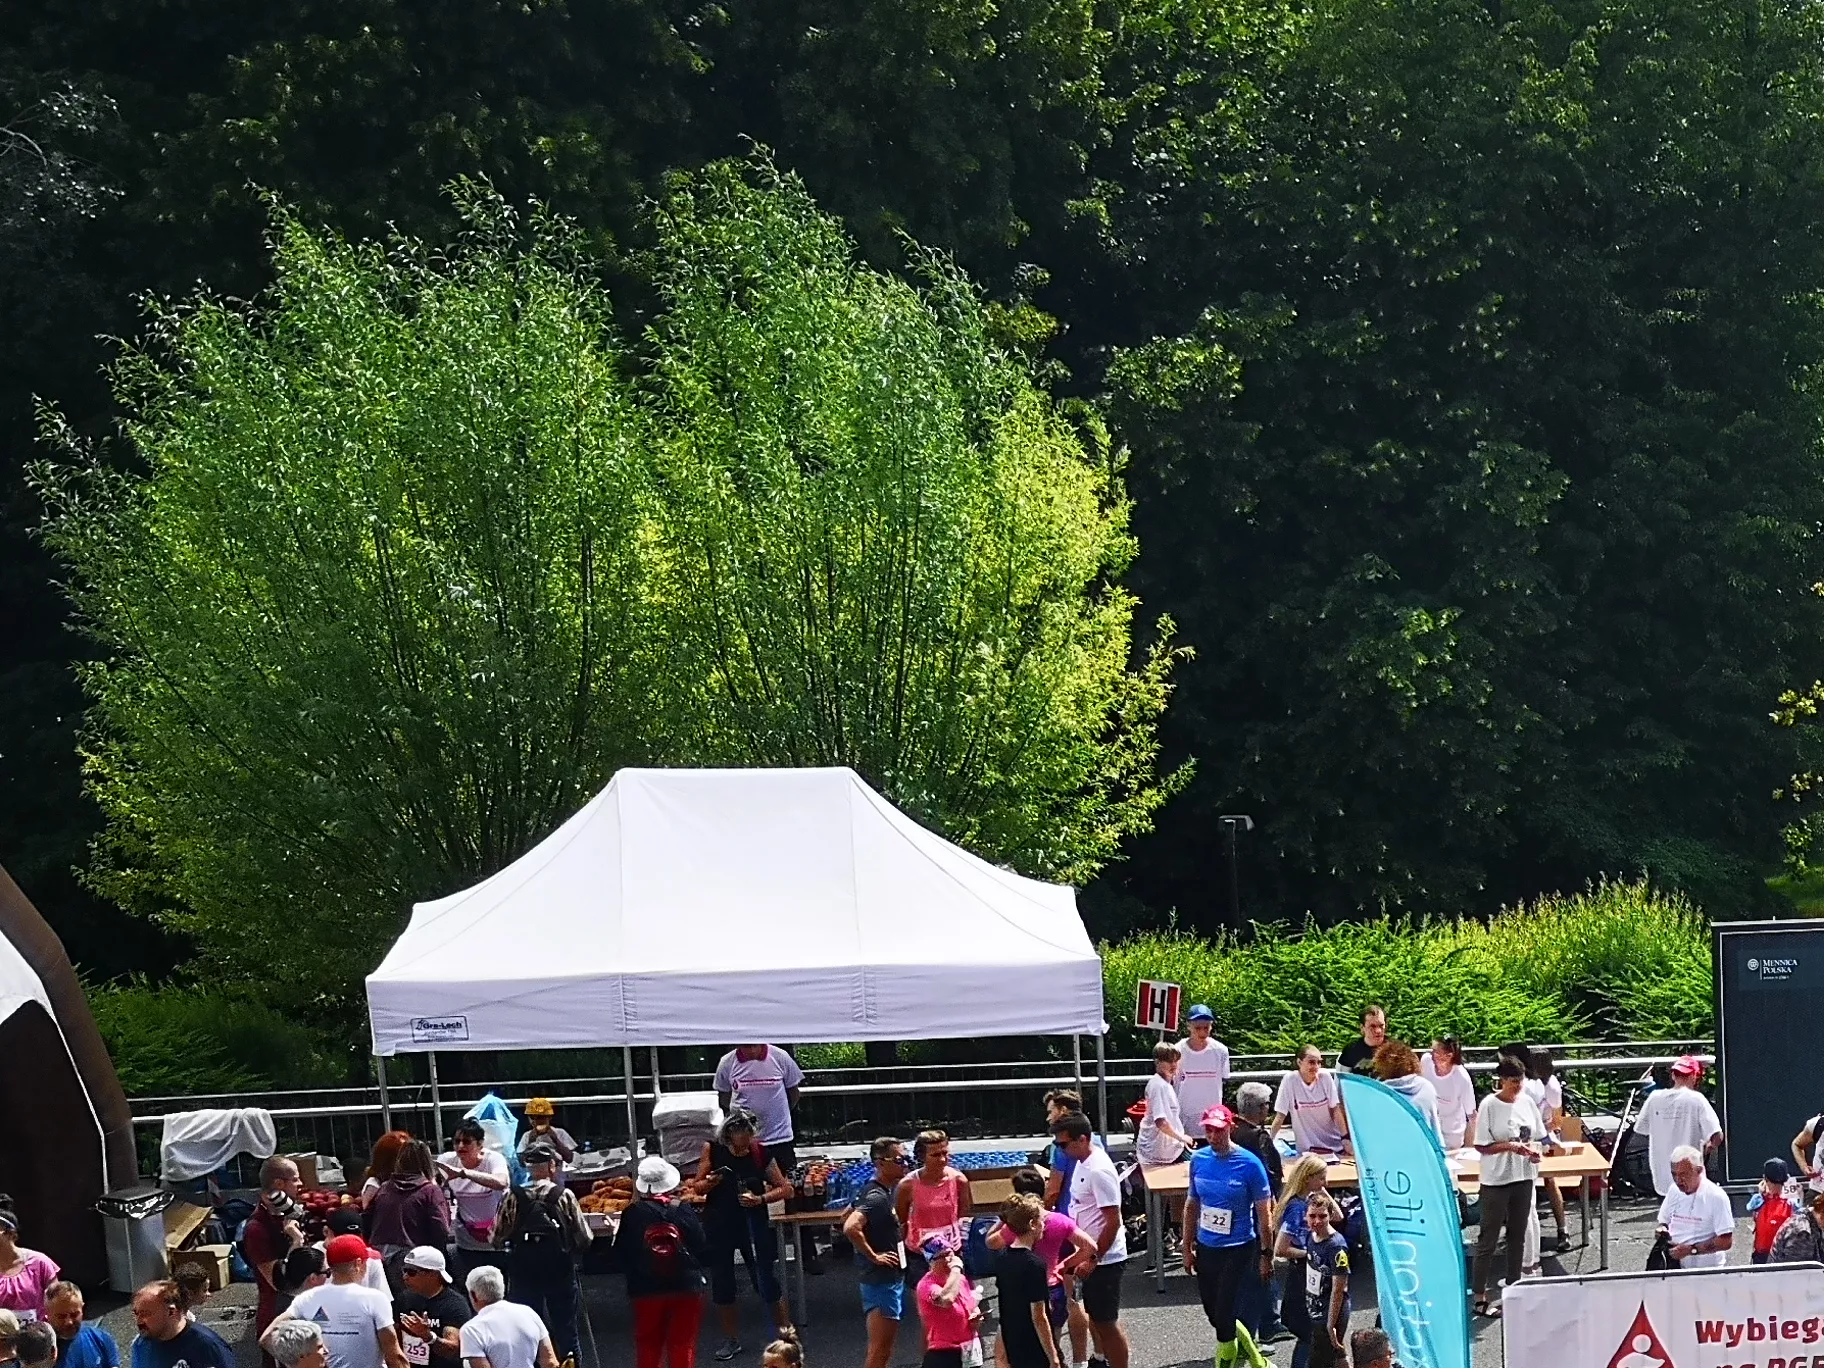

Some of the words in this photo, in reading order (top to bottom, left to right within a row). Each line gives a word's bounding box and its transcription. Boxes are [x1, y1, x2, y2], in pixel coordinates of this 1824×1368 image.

[1763, 959, 1798, 967] MENNICA
[1763, 967, 1793, 975] POLSKA
[1150, 988, 1165, 1025] H
